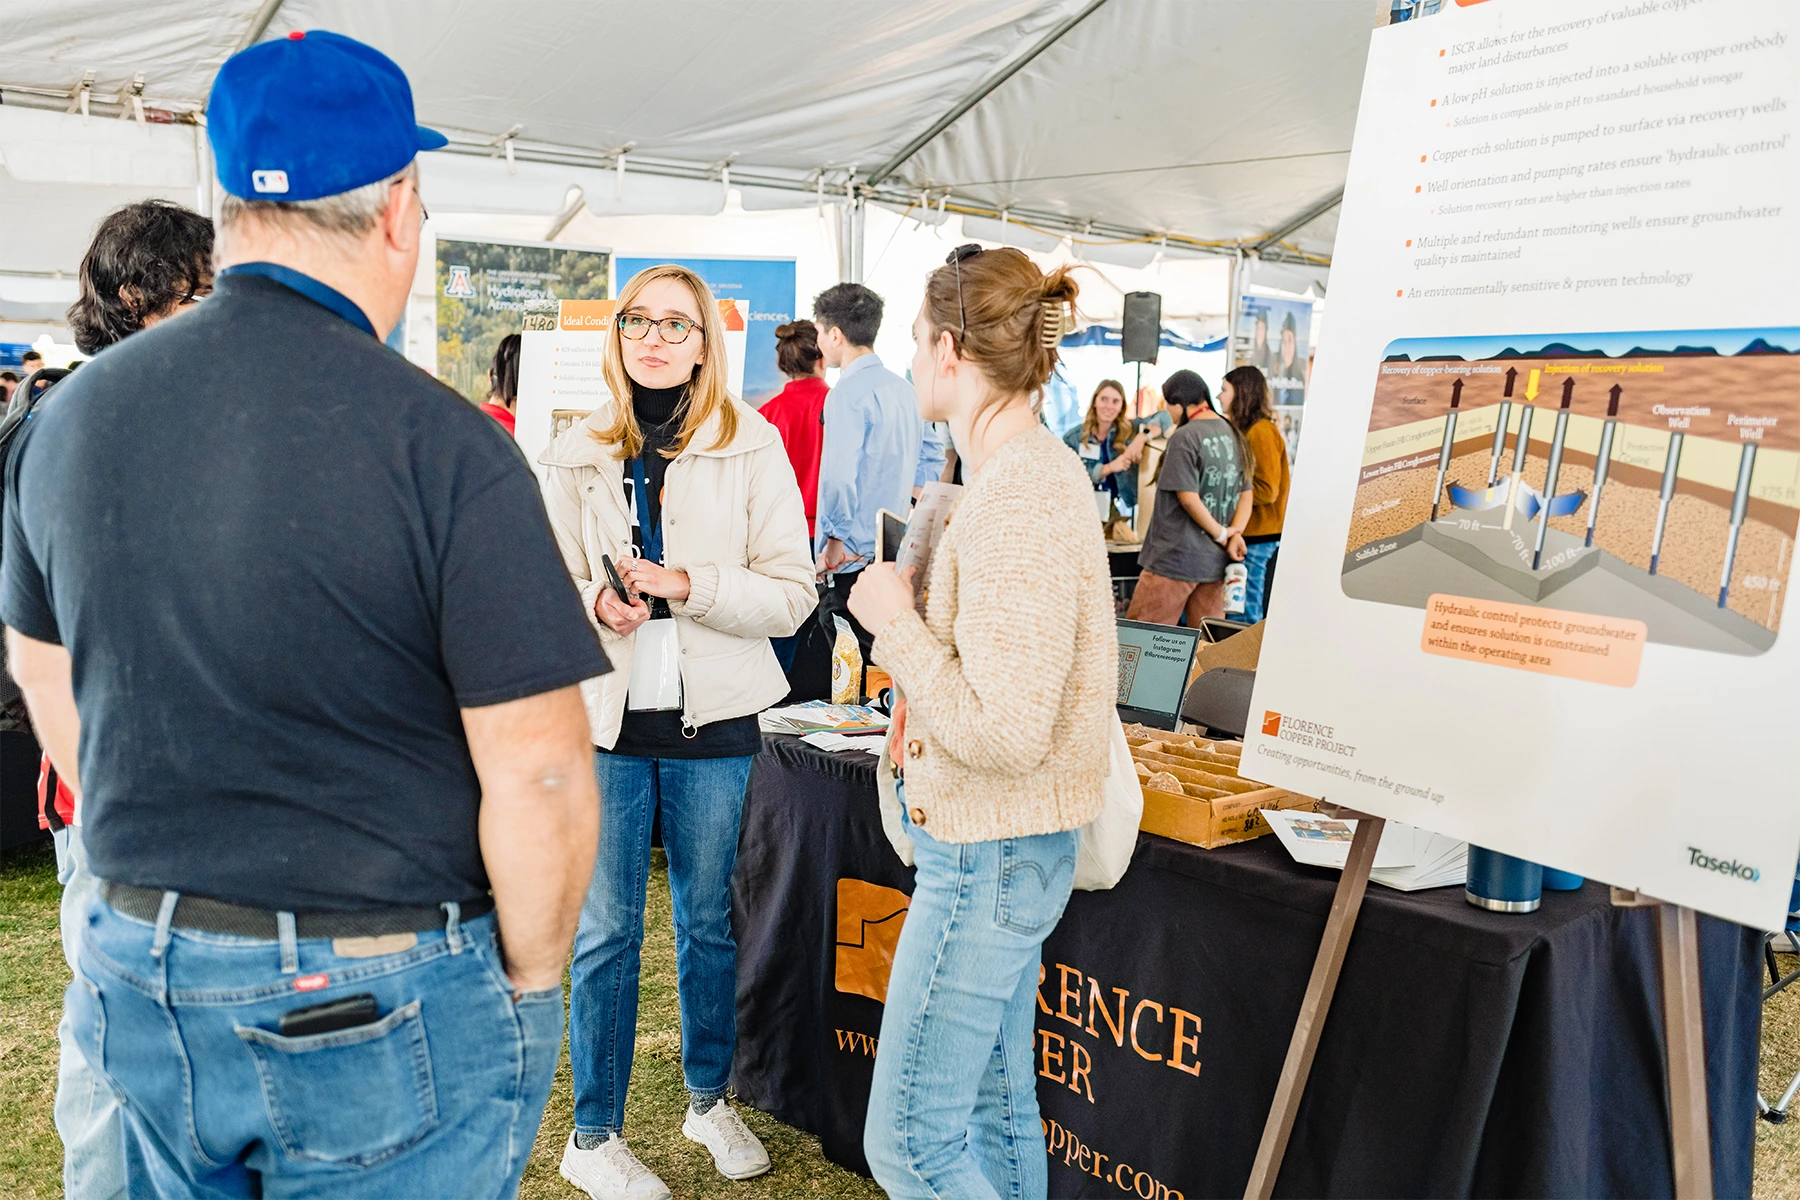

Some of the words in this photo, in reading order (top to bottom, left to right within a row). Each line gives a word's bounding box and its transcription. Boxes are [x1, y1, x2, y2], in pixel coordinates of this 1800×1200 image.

[1451, 41, 1475, 56] ISCR
[1476, 36, 1507, 51] allows
[1510, 30, 1525, 44] for
[1528, 26, 1544, 40] the
[1547, 16, 1594, 35] recovery
[1596, 9, 1612, 24] of
[1612, 1, 1659, 20] valuable
[1448, 60, 1476, 75] major
[1478, 53, 1500, 68] land
[1502, 41, 1569, 63] disturbances
[1441, 95, 1449, 106] A
[1451, 93, 1471, 105] low
[1471, 88, 1488, 104] pH
[1489, 81, 1533, 97] solution
[1536, 78, 1545, 89] is
[1547, 67, 1593, 88] injected
[1595, 64, 1620, 78] into
[1623, 63, 1629, 72] a
[1633, 52, 1678, 71] soluble
[1681, 45, 1727, 63] copper
[1730, 32, 1788, 54] orebody
[1453, 114, 1489, 128] Solution
[1491, 111, 1498, 121] is
[1500, 101, 1551, 120] comparable
[1554, 100, 1563, 110] in
[1565, 96, 1581, 111] pH
[1583, 94, 1593, 105] to
[1594, 84, 1641, 103] standard
[1643, 76, 1700, 95] household
[1702, 70, 1745, 86] vinegar
[1432, 142, 1491, 163] Copper-rich
[1494, 136, 1537, 151] solution
[1540, 134, 1549, 146] is
[1551, 124, 1600, 147] pumped
[1603, 124, 1615, 136] to
[1618, 117, 1663, 134] surface
[1667, 113, 1685, 127] via
[1689, 105, 1748, 124] recovery
[1752, 96, 1788, 115] wells
[1427, 179, 1448, 193] Well
[1450, 173, 1508, 191] orientation
[1511, 168, 1531, 182] and
[1533, 163, 1584, 184] pumping
[1587, 159, 1617, 173] rates
[1620, 153, 1662, 169] ensure
[1438, 204, 1473, 216] Solution
[1475, 198, 1513, 213] recovery
[1514, 195, 1537, 207] rates
[1538, 194, 1553, 204] are
[1555, 189, 1587, 205] higher
[1590, 186, 1612, 198] than
[1615, 180, 1661, 197] injection
[1664, 178, 1691, 190] rates
[1417, 234, 1459, 250] Multiple
[1461, 231, 1481, 245] and
[1482, 226, 1539, 243] redundant
[1542, 220, 1608, 236] monitoring
[1612, 216, 1642, 231] wells
[1645, 213, 1689, 229] ensure
[1691, 205, 1783, 228] groundwater
[1414, 254, 1448, 270] quality
[1450, 253, 1458, 264] is
[1460, 246, 1521, 263] maintained
[487, 284, 546, 300] Hydrology
[1408, 287, 1421, 299] An
[1424, 281, 1508, 298] environmentally
[1511, 279, 1560, 293] sensitive
[1563, 277, 1573, 289] &
[1575, 276, 1617, 293] proven
[1621, 270, 1694, 287] technology
[563, 315, 583, 326] Ideal
[1382, 365, 1411, 376] Recovery
[1412, 364, 1420, 374] of
[1420, 364, 1471, 377] copper-bearing
[1472, 364, 1502, 374] solution
[1544, 363, 1582, 375] Injection
[1582, 363, 1590, 373] of
[1590, 364, 1627, 375] recovery
[1627, 363, 1664, 373] solution
[1402, 396, 1427, 405] Surface
[1652, 404, 1711, 416] Observation
[1668, 417, 1690, 429] Well
[1728, 414, 1778, 427] Perimeter
[1739, 428, 1764, 440] Well
[1366, 443, 1382, 455] Upper
[1363, 468, 1379, 479] Lower
[1379, 464, 1394, 474] Basin
[1786, 486, 1796, 499] ft
[1362, 503, 1382, 517] Oxide
[1383, 498, 1400, 509] Zone
[1459, 519, 1470, 530] 70
[1471, 520, 1480, 531] ft
[1356, 547, 1379, 561] Sulfide
[1379, 542, 1397, 553] Zone
[1512, 535, 1525, 550] 70
[1518, 549, 1529, 562] ft
[1545, 552, 1566, 570] 100
[1565, 547, 1576, 560] ft
[1742, 575, 1768, 589] 450
[1768, 577, 1781, 591] ft
[1434, 601, 1480, 618] Hydraulic
[1482, 610, 1519, 623] control
[1519, 614, 1567, 631] protects
[1564, 623, 1637, 641] groundwater
[1152, 635, 1171, 644] Follow
[1430, 620, 1449, 631] and
[1450, 624, 1487, 638] ensures
[1489, 628, 1531, 644] solution
[1533, 633, 1543, 646] is
[1544, 638, 1610, 656] constrained
[1144, 650, 1186, 663] @florencecopper
[1153, 644, 1182, 654] Instagram
[1428, 636, 1458, 651] within
[1460, 641, 1477, 653] the
[1479, 646, 1527, 665] operating
[1529, 654, 1552, 666] area
[1282, 715, 1334, 739] FLORENCE
[1279, 729, 1314, 747] COPPER
[1315, 737, 1356, 757] PROJECT
[1257, 743, 1292, 765] Creating
[1293, 755, 1352, 780] opportunities,
[1353, 769, 1377, 786] from
[1378, 775, 1394, 790] the
[1394, 781, 1431, 800] ground
[1431, 792, 1445, 806] up
[1687, 846, 1754, 880] Taseko
[1036, 962, 1202, 1077] RENCE
